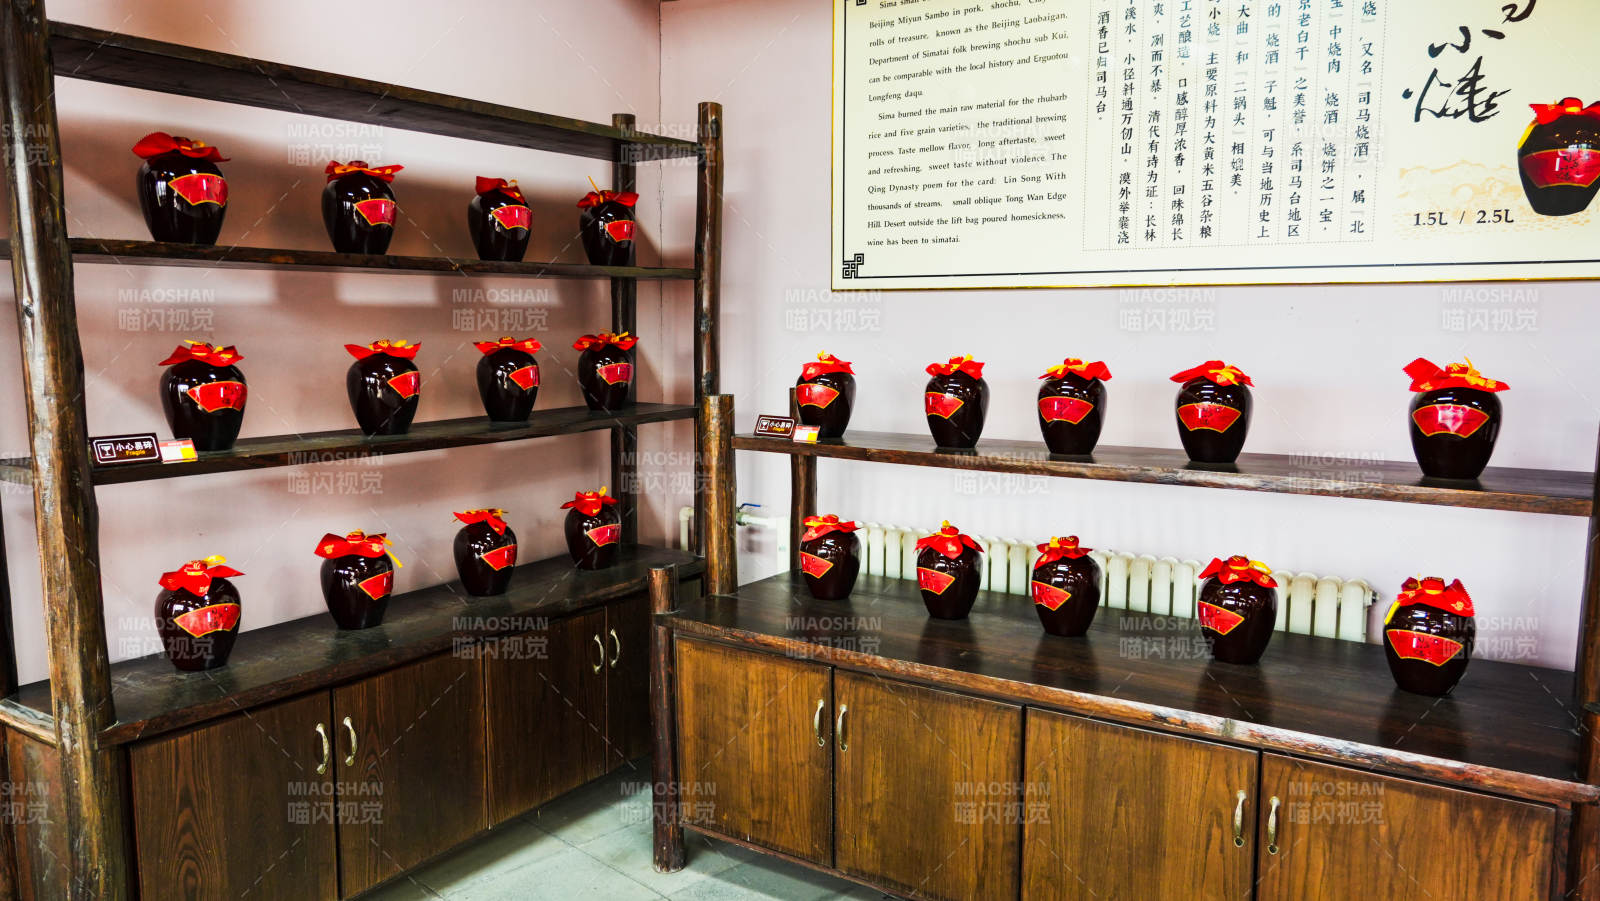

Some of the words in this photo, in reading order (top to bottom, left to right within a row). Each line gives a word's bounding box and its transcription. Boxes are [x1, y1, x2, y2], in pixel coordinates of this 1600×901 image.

[869, 19, 895, 29] Beijing
[898, 16, 922, 24] Miyun
[924, 10, 950, 20] Sambo
[952, 8, 961, 16] in
[964, 4, 984, 16] pork,
[991, 0, 1021, 9] shochu,
[869, 38, 885, 48] rolls
[887, 36, 895, 45] of
[936, 28, 961, 38] known
[976, 23, 988, 32] the
[992, 18, 1020, 29] Beijing
[869, 54, 909, 66] Department
[912, 51, 920, 60] of
[922, 47, 949, 58] Simatai
[952, 45, 967, 54] folk
[970, 41, 1001, 52] brewing
[1004, 37, 1031, 47] shochu
[1034, 34, 1048, 42] sub
[868, 75, 882, 84] can
[883, 73, 892, 82] be
[894, 68, 933, 80] comparable
[935, 66, 952, 75] with
[955, 64, 967, 73] the
[969, 61, 986, 70] local
[988, 60, 1014, 69] history
[1016, 56, 1031, 65] and
[1033, 53, 1068, 64] Erguotou
[868, 92, 902, 102] Longfeng
[878, 112, 895, 120] Sima
[898, 108, 922, 118] burned
[925, 107, 937, 116] the
[939, 105, 958, 114] main
[976, 99, 1005, 110] material
[1008, 98, 1019, 106] for
[1022, 96, 1034, 105] the
[1037, 92, 1068, 103] rhubarb
[868, 131, 882, 140] rice
[884, 130, 897, 138] and
[900, 128, 914, 136] five
[916, 126, 936, 136] grain
[977, 120, 990, 128] the
[992, 116, 1033, 127] traditional
[1035, 113, 1067, 123] brewing
[898, 147, 916, 155] Taste
[919, 144, 944, 153] mellow
[978, 140, 995, 148] long
[1044, 133, 1066, 142] sweet
[868, 167, 881, 175] and
[928, 162, 950, 170] sweet
[953, 161, 972, 169] taste
[976, 157, 1007, 167] without
[1051, 152, 1067, 161] The
[867, 185, 886, 195] Qing
[889, 184, 920, 193] Dynasty
[922, 182, 943, 192] poem
[946, 180, 958, 188] for
[961, 179, 974, 187] the
[1004, 176, 1017, 184] Lin
[1020, 174, 1042, 184] Song
[1045, 172, 1066, 181] With
[867, 202, 902, 211] thousands
[952, 197, 972, 206] small
[974, 196, 1002, 206] oblique
[1006, 194, 1024, 204] Tong
[1027, 193, 1044, 201] Wan
[1047, 192, 1067, 202] Edge
[884, 220, 906, 228] Desert
[908, 218, 934, 227] outside
[951, 216, 963, 224] lift
[965, 216, 979, 226] bag
[982, 214, 1008, 225] poured
[1413, 210, 1448, 226] 1.5L
[1476, 208, 1515, 224] 2.5L
[867, 238, 884, 246] wine
[886, 238, 899, 246] has
[901, 237, 918, 245] been
[116, 442, 152, 451] 小心易碎
